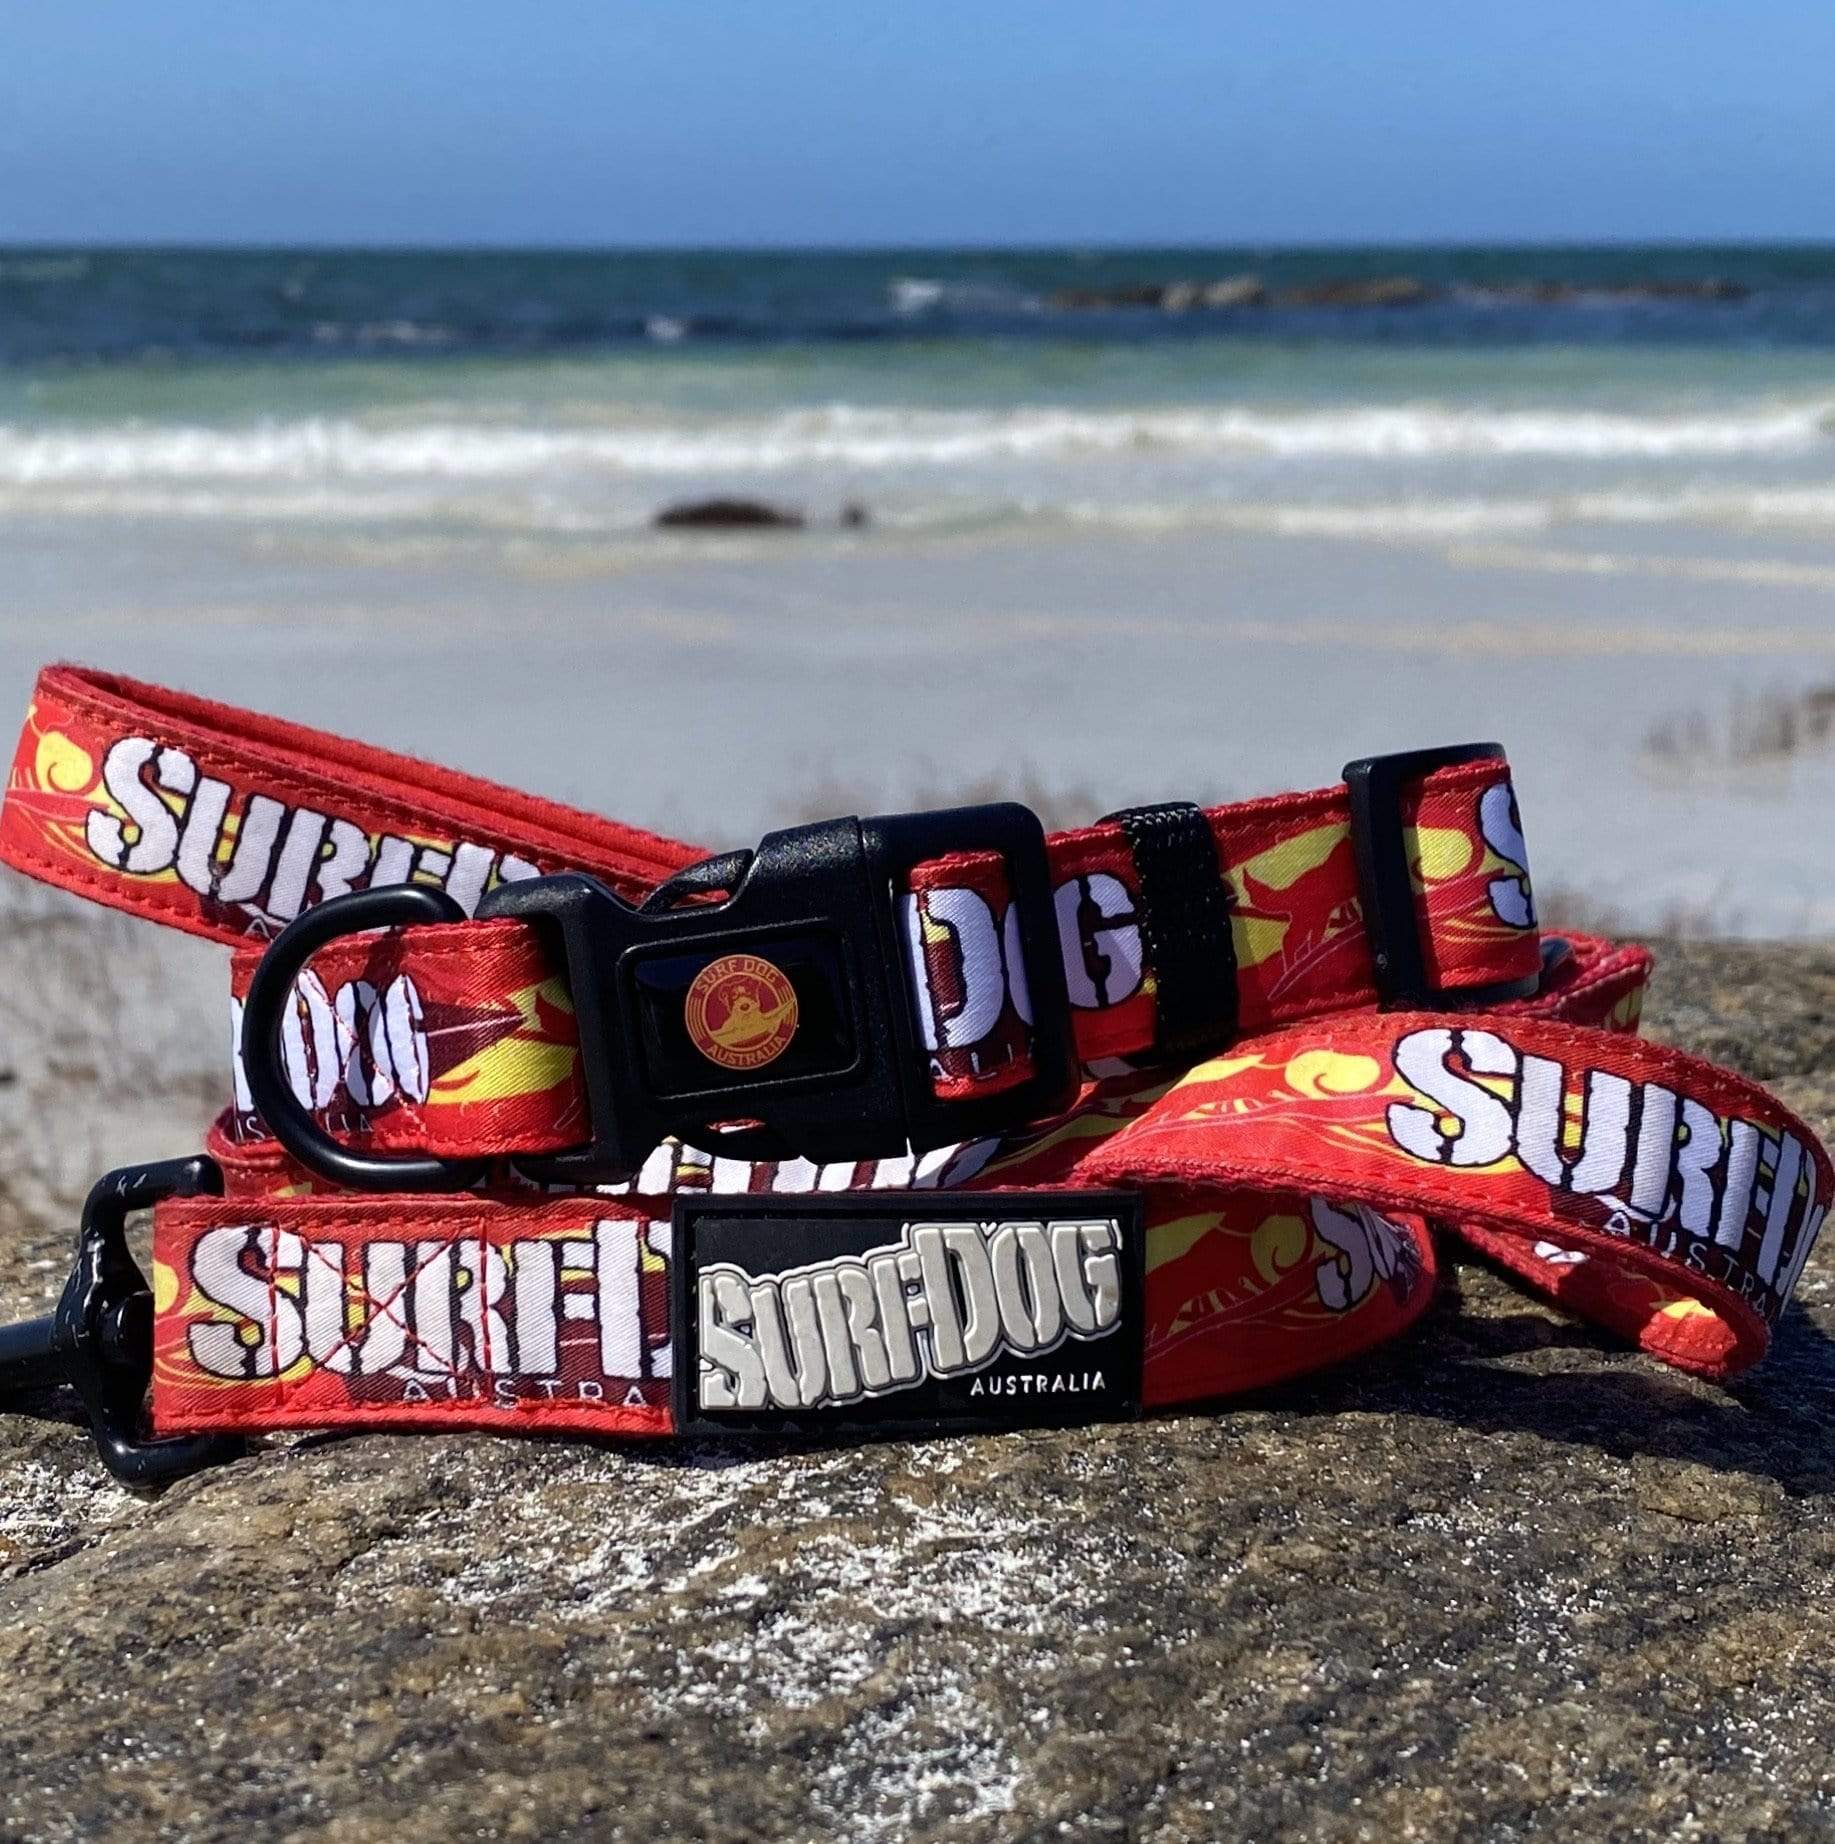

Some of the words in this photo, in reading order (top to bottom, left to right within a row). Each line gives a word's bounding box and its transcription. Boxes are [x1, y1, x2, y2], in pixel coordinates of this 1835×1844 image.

[696, 959, 739, 994] SURF
[743, 960, 779, 984] DOG
[706, 1035, 787, 1066] AUSTRALIA
[970, 1371, 1106, 1397] AUSTRALIA
